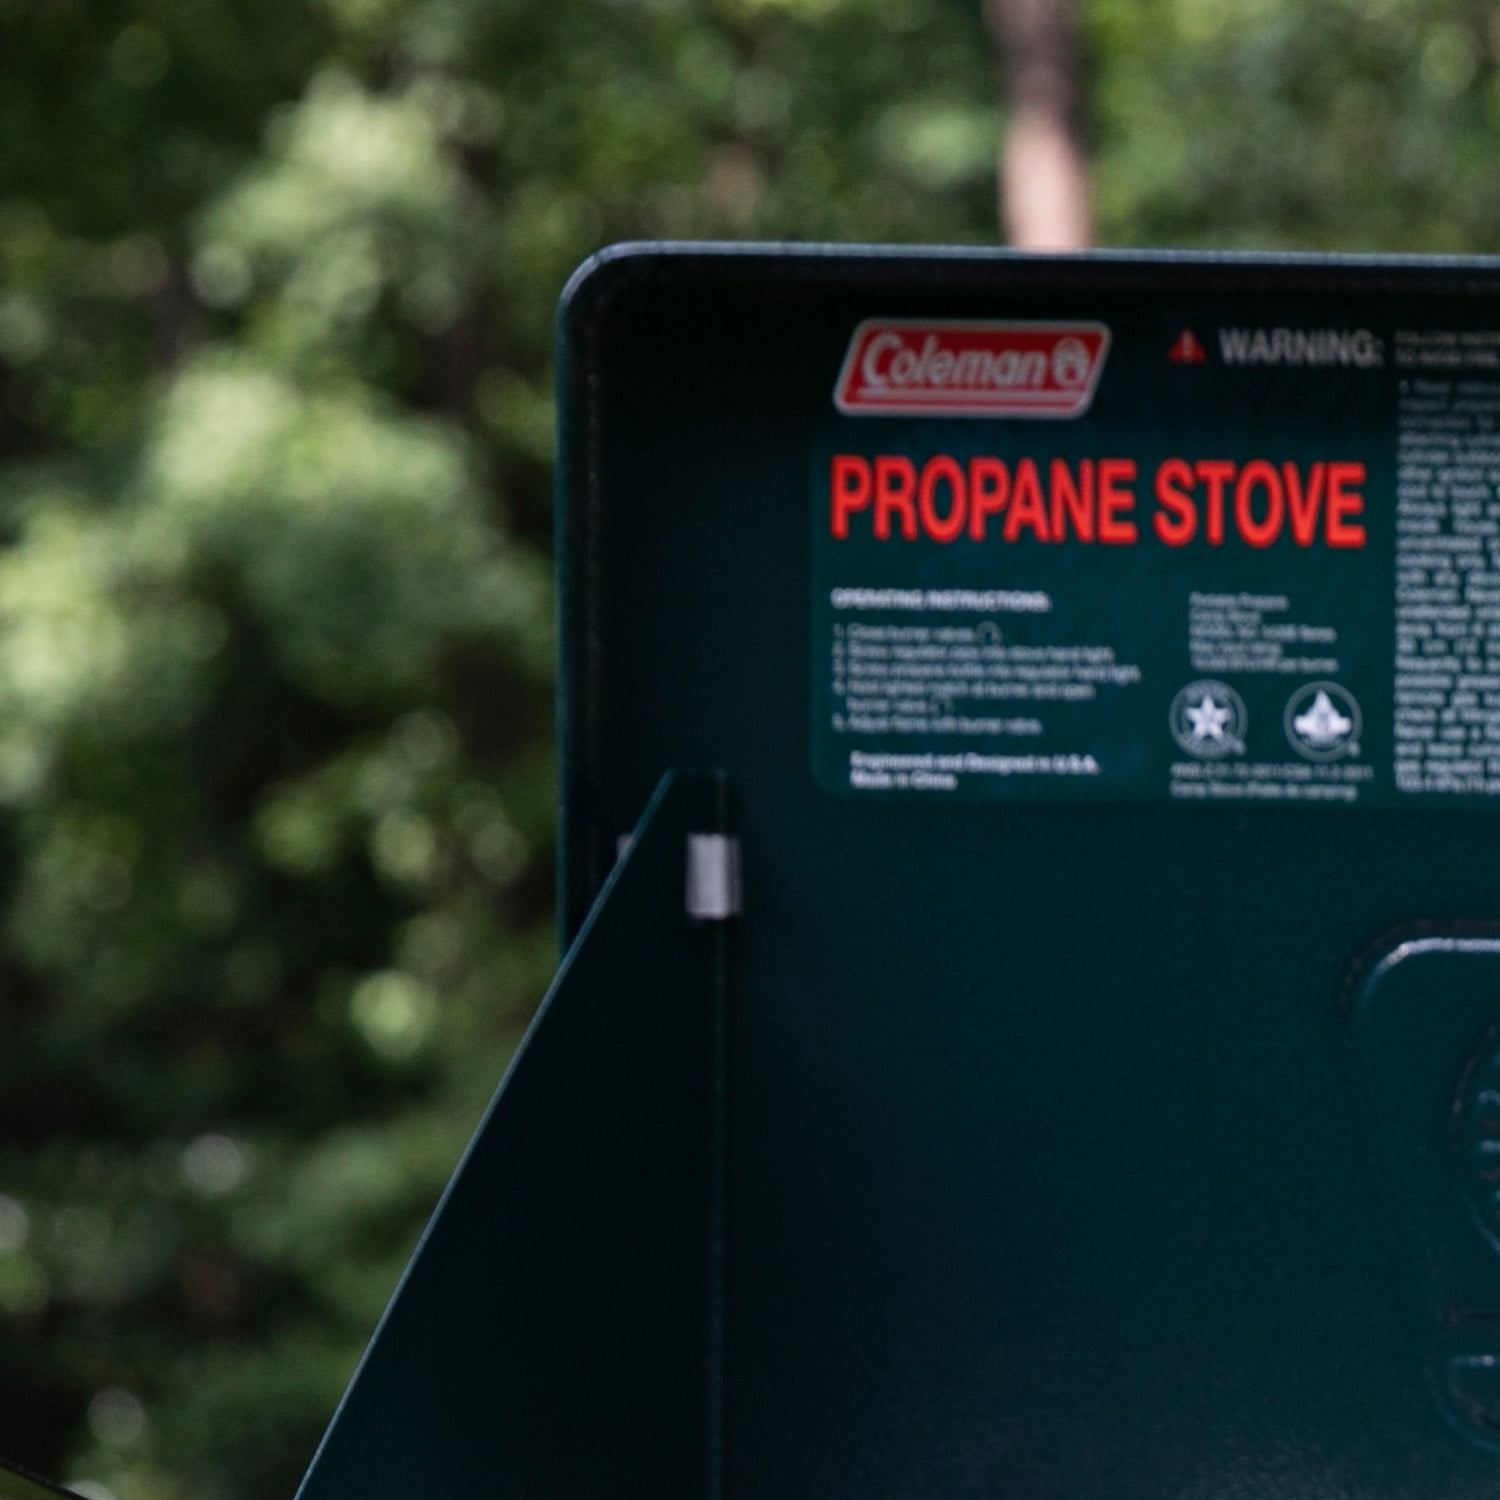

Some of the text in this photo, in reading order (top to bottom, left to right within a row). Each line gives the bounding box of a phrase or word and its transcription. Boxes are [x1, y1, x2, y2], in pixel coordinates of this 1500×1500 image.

[861, 331, 1048, 389] Coleman
[1219, 329, 1384, 367] WARNING:
[830, 455, 1367, 549] PROPANE STOVE
